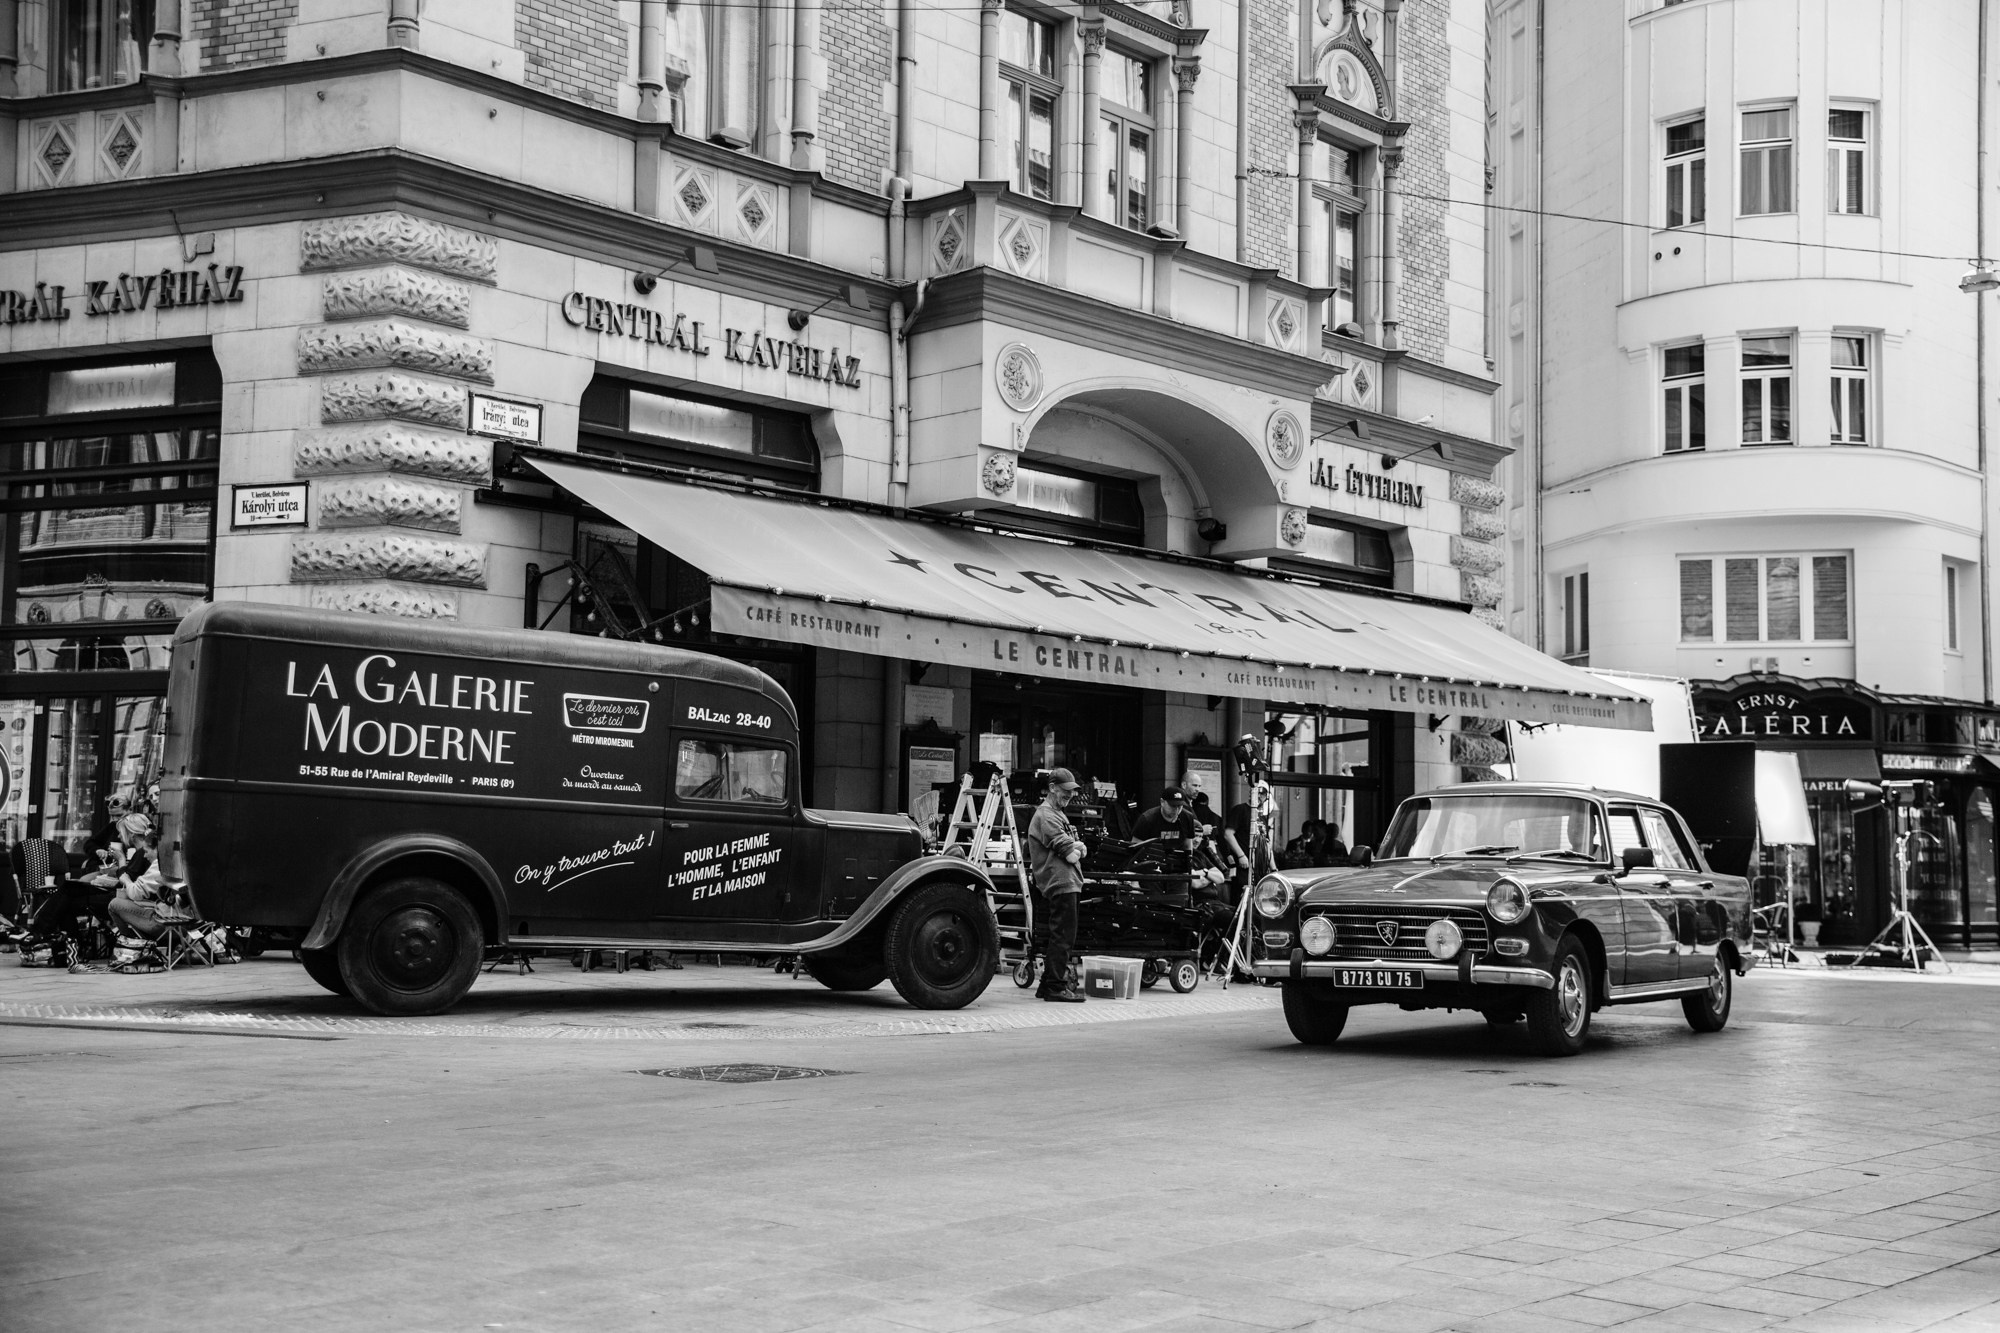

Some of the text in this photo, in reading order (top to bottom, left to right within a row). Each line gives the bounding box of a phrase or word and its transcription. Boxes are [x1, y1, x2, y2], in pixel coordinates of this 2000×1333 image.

[0, 262, 244, 323] RÁL KÁVÉHÁZ
[561, 291, 861, 388] CENTRÁL KÁVÉHÁZ
[512, 414, 529, 428] utca
[1310, 457, 1425, 508] ÁL ÉTTEREM
[242, 499, 299, 515] Károlyi utca
[953, 562, 1360, 634] CENTRAL
[746, 605, 782, 624] CAFÉ
[790, 612, 881, 639] RESTAURANT
[993, 638, 1019, 662] LE
[1035, 645, 1139, 678] CENTRAL
[1227, 671, 1251, 686] CAFÉ
[1256, 674, 1316, 691] RESTAURANT
[1389, 685, 1407, 703] LE
[1416, 687, 1488, 709] CENTRAL
[287, 654, 535, 715] LA GALERIE
[570, 699, 640, 716] Le dernier cri,
[1737, 694, 1799, 711] ERNST
[587, 713, 625, 726] c'est ici!
[736, 712, 772, 729] 28-40
[304, 702, 517, 765] MODERNE
[572, 733, 635, 748] MÉTRO MIROMESNIL
[299, 765, 328, 776] 51-55
[330, 767, 349, 778] Rue
[352, 768, 363, 778] de
[365, 769, 404, 781] l'Amiral
[407, 771, 453, 784] Reydeville
[472, 777, 498, 787] PARIS
[562, 778, 573, 787] du
[574, 780, 600, 790] mardi
[614, 782, 642, 792] samedi
[580, 764, 624, 780] Ouverture
[514, 864, 542, 884] On
[544, 864, 557, 886] y
[558, 848, 611, 872] trouve
[612, 833, 645, 857] tout
[683, 832, 770, 866] POUR LA FEMME
[668, 848, 782, 888] L'HOMME, L'ENFANT
[692, 871, 767, 901] ET LA MAISON
[1342, 970, 1412, 986] 8773 CU 75
